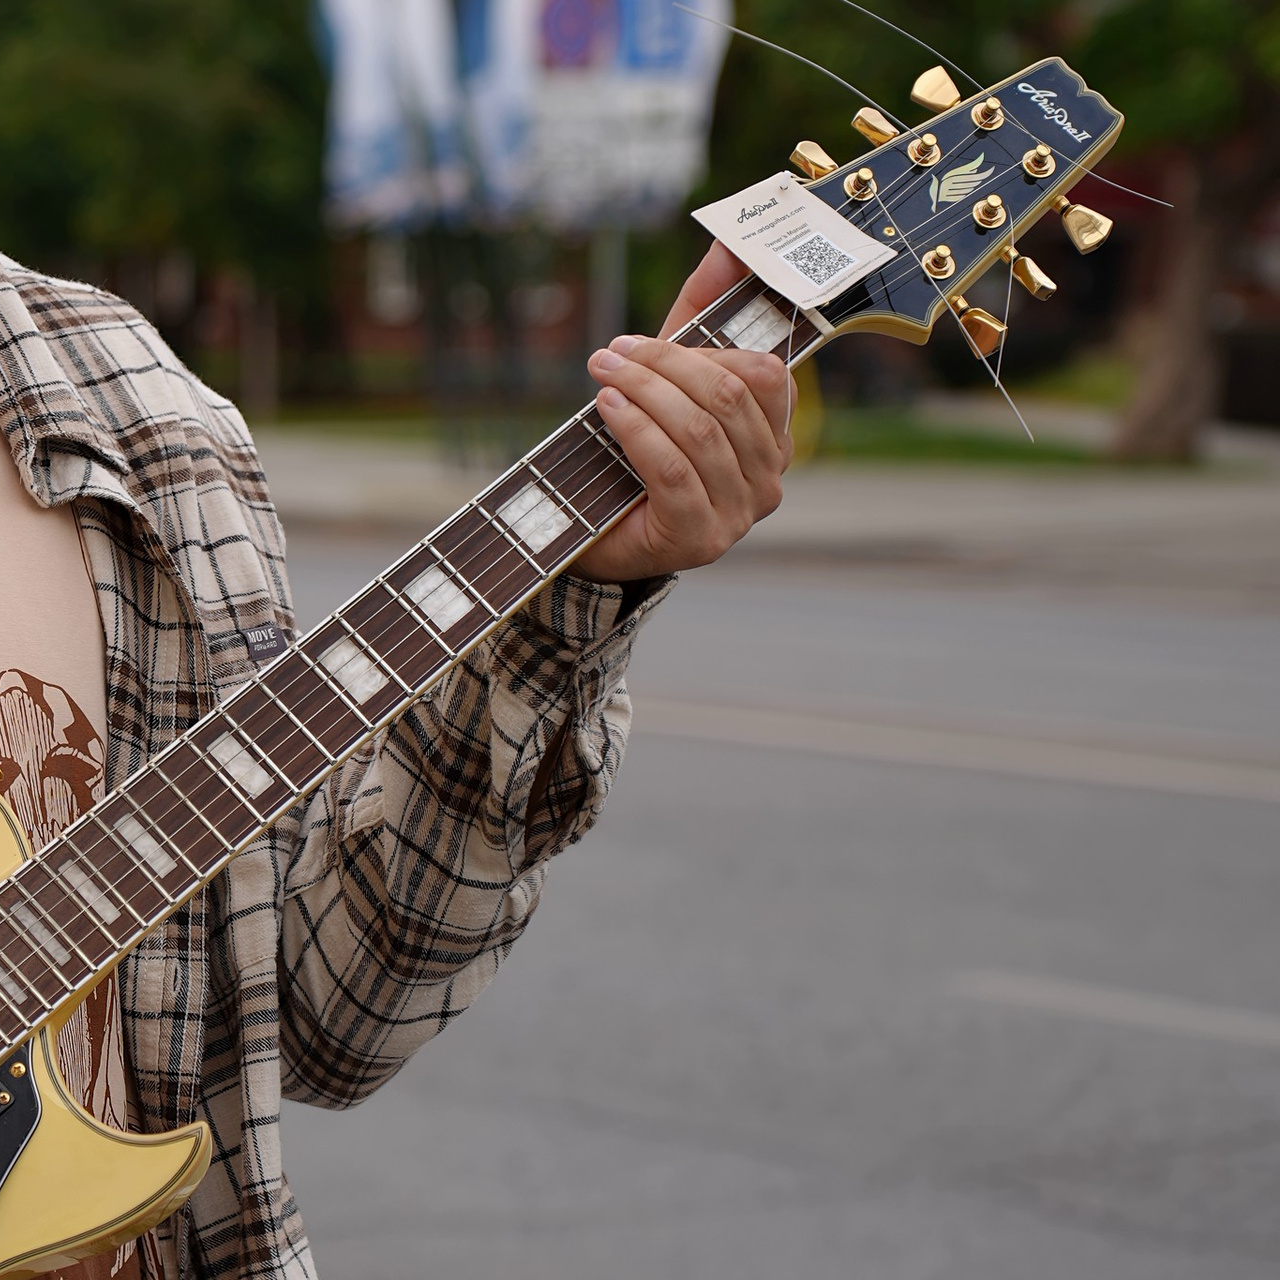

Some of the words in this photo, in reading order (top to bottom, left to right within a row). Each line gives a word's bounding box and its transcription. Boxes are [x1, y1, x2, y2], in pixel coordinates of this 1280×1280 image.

[740, 205, 806, 241] www.ariaguitars.com
[786, 222, 809, 237] Manual
[771, 228, 812, 253] Downloadable
